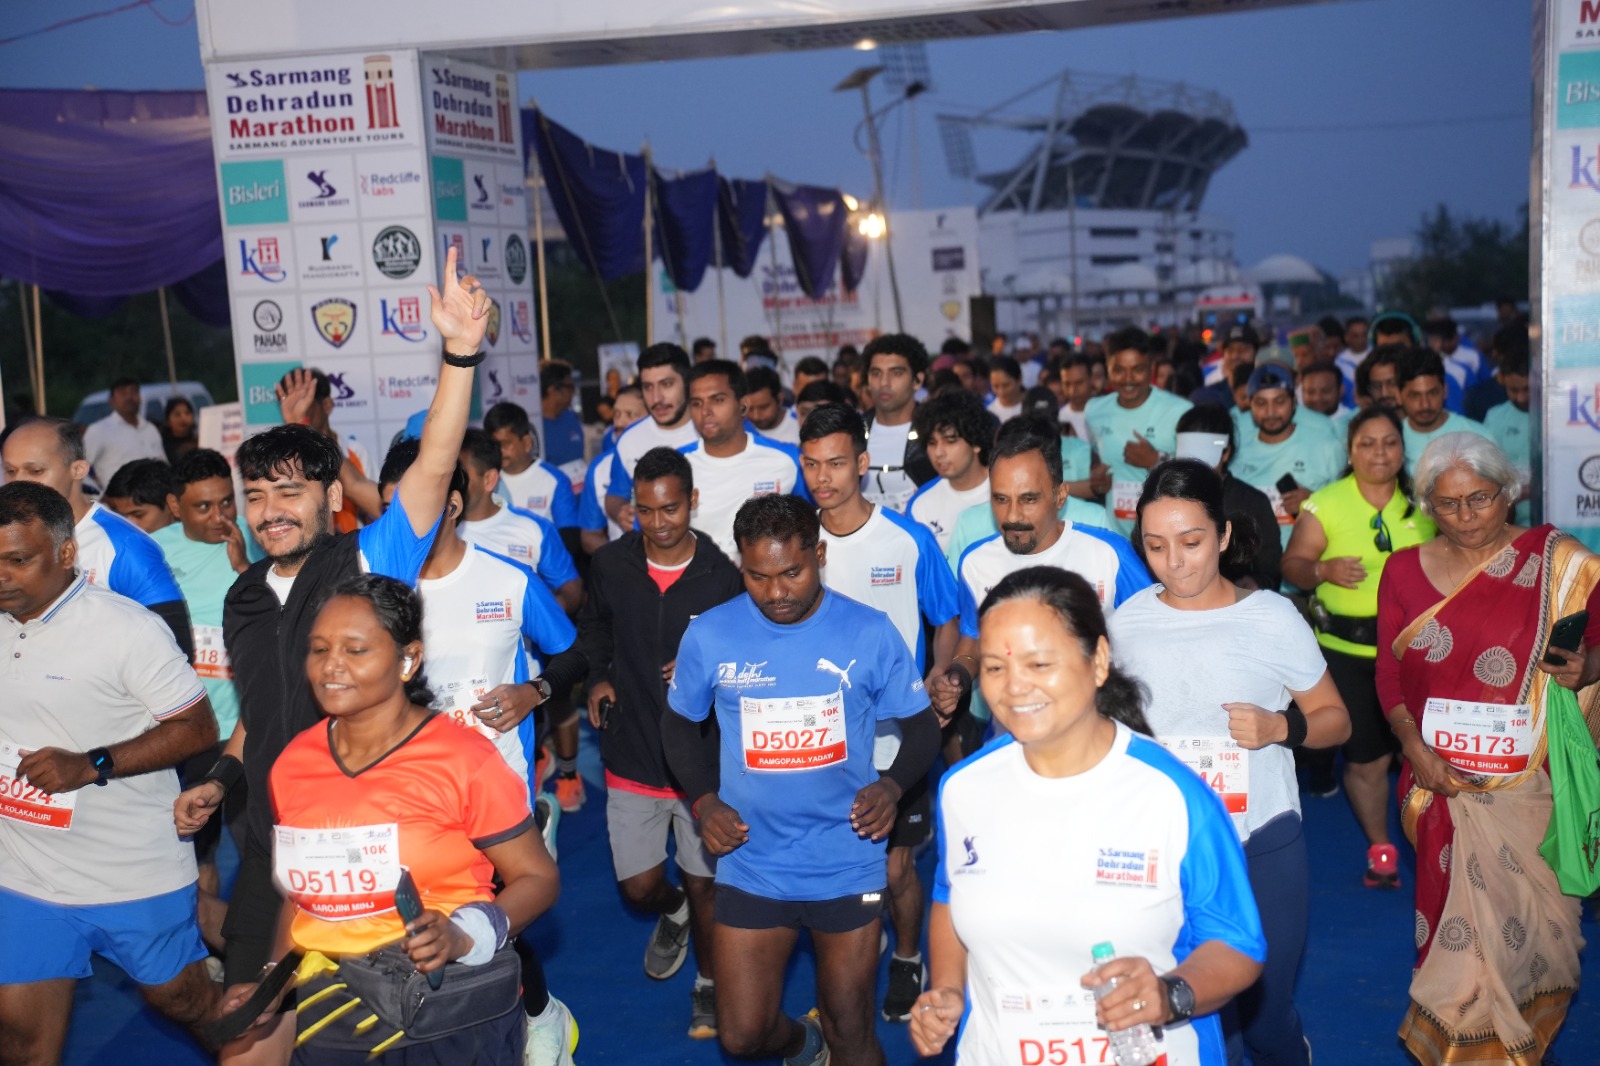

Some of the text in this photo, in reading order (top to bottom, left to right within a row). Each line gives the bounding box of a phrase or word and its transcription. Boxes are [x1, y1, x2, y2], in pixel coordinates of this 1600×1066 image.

[250, 67, 352, 88] Sarmang
[443, 68, 492, 98] Sarmang
[227, 91, 353, 114] Dehradun
[433, 90, 493, 118] Dehradun
[230, 115, 355, 138] Marathon
[435, 113, 495, 141] Marathon
[229, 133, 405, 150] SARMANG ADVENTURE TOURS
[371, 172, 420, 185] Redcliffe
[228, 180, 280, 206] Bisleri
[254, 333, 287, 347] PAHADI
[388, 376, 438, 388] Redcliffe
[250, 384, 276, 406] Bis
[476, 606, 504, 614] Dehradun
[821, 706, 839, 717] 10K
[1510, 718, 1528, 727] 10K
[752, 727, 829, 751] D5027
[1434, 730, 1515, 755] D5173
[759, 757, 806, 765] RAMGOPAAL
[1217, 752, 1240, 761] 10K
[362, 844, 388, 856] 10K
[1097, 858, 1145, 870] Dehradun
[288, 868, 377, 894] D5119
[1096, 869, 1144, 882] Marathon
